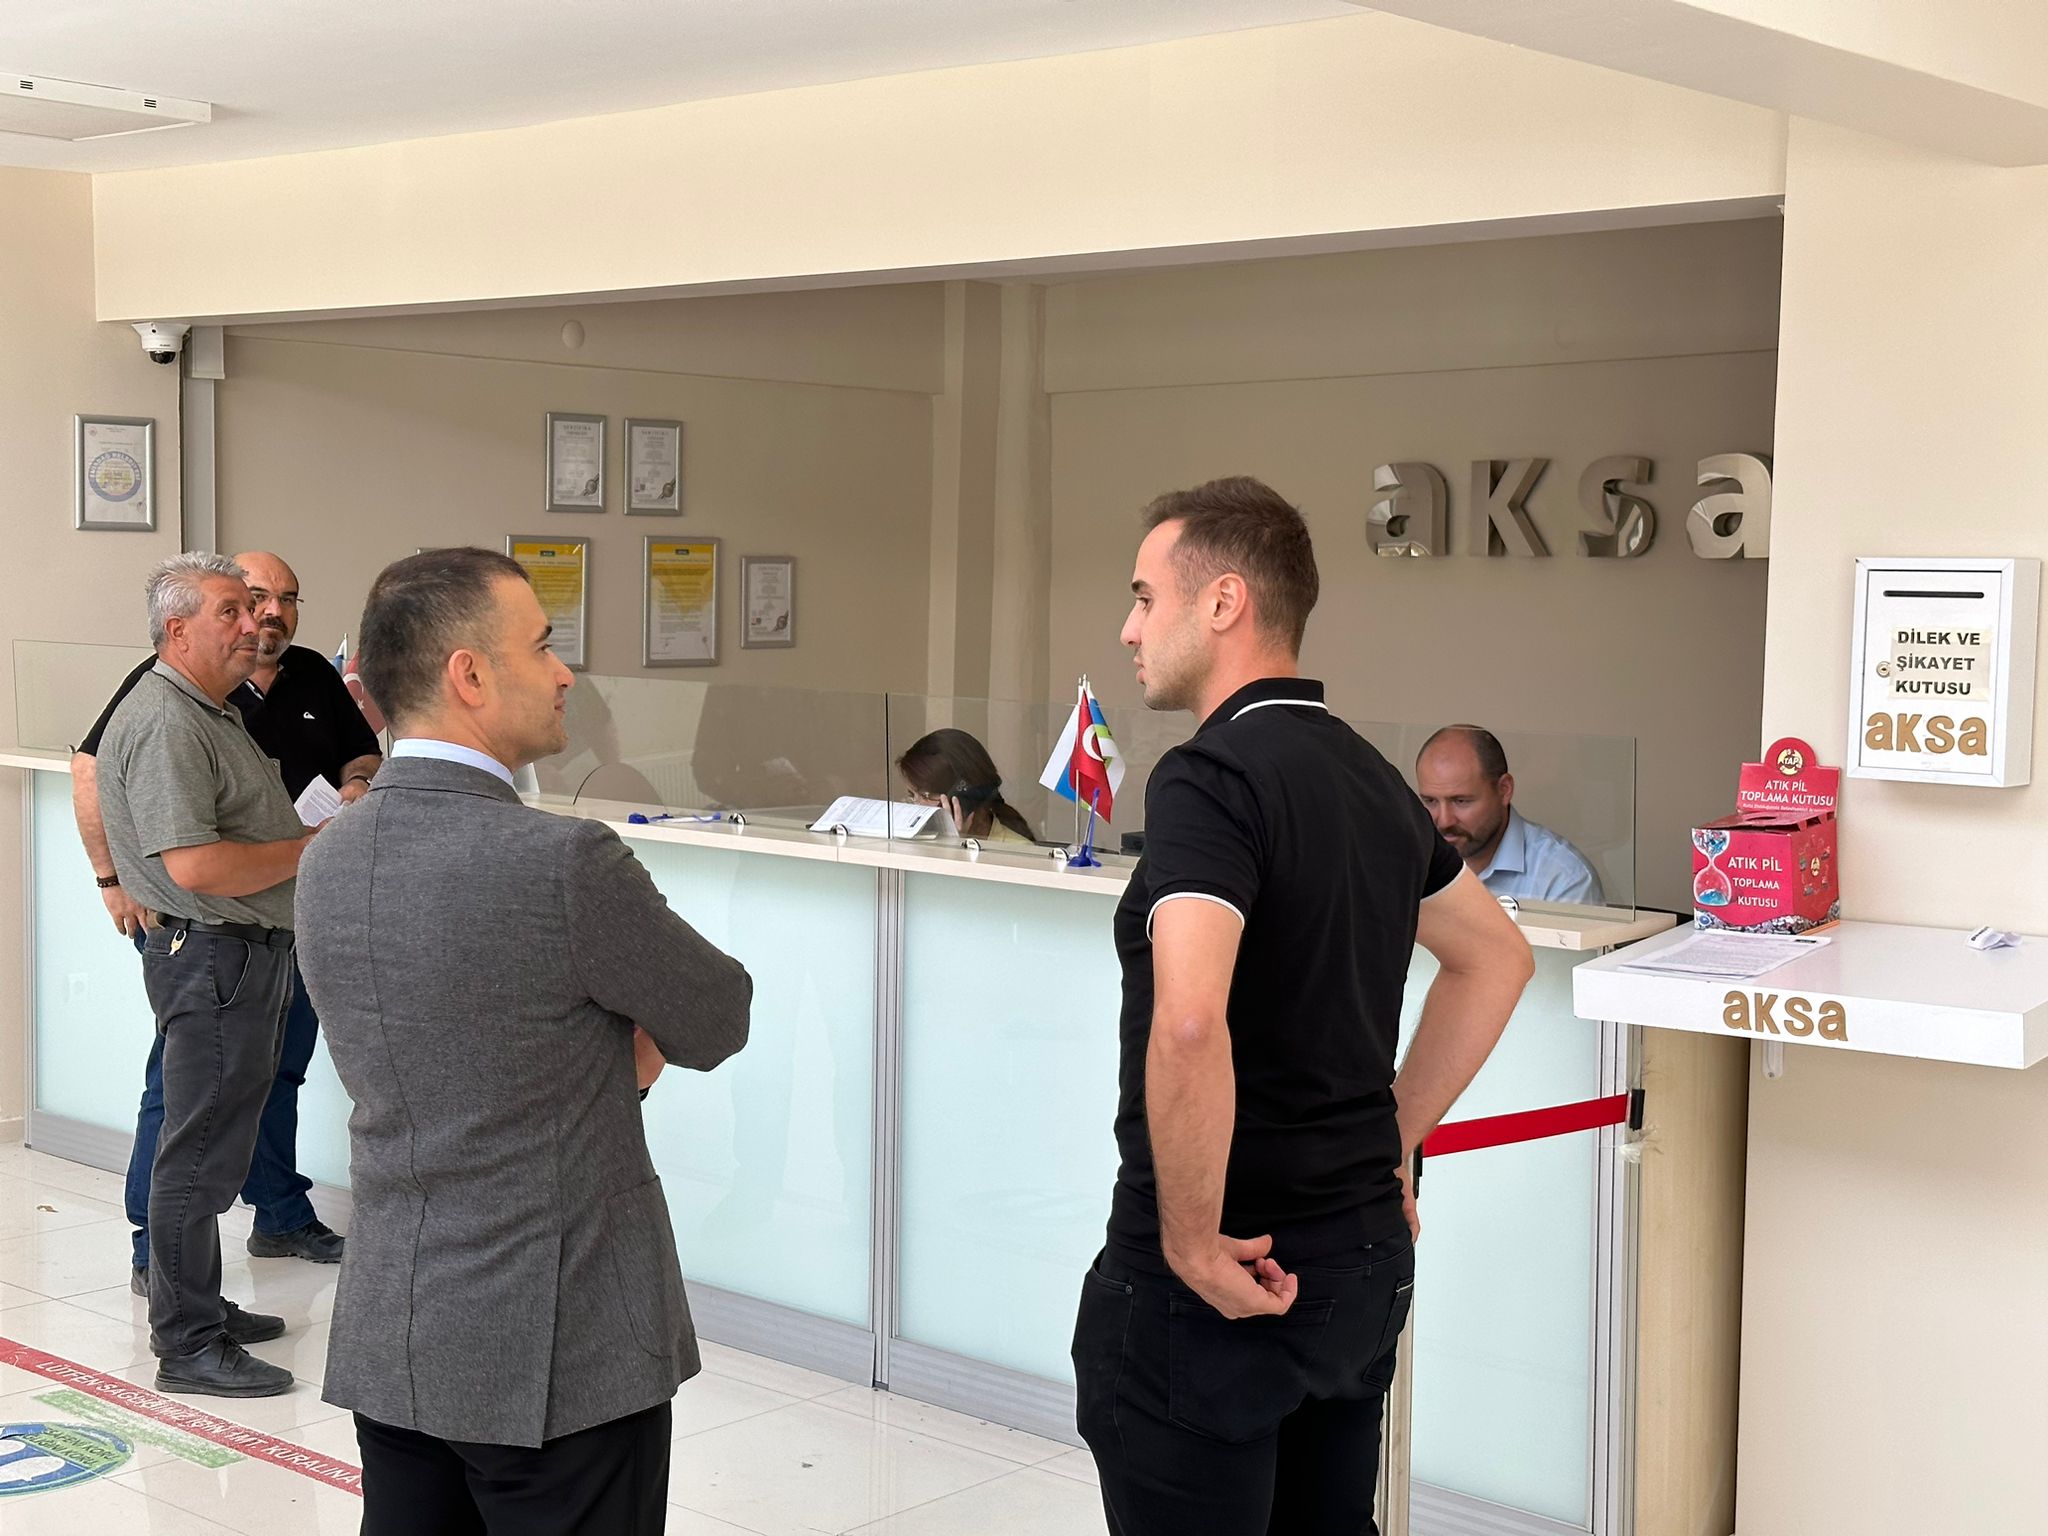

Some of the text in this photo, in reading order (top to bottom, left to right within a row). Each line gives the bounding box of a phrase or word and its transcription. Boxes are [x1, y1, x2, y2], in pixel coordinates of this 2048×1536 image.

[1366, 453, 1773, 559] aksa
[1897, 628, 1980, 646] DİLEK VE
[1896, 653, 1975, 671] ŞİKAYET
[1895, 680, 1971, 695] KUTUSU
[1865, 712, 1987, 756] aksa
[1765, 779, 1808, 792] ATIK PİL
[1740, 791, 1834, 807] TOPLAMA KUTUSU
[1728, 857, 1783, 872] ATIK PİL
[1733, 878, 1780, 890] TOPLAMA
[1738, 896, 1778, 908] KUTUSU
[1723, 990, 1848, 1041] aksa
[35, 1362, 104, 1387] LÜTFEN
[265, 1445, 361, 1486] KURALINA
